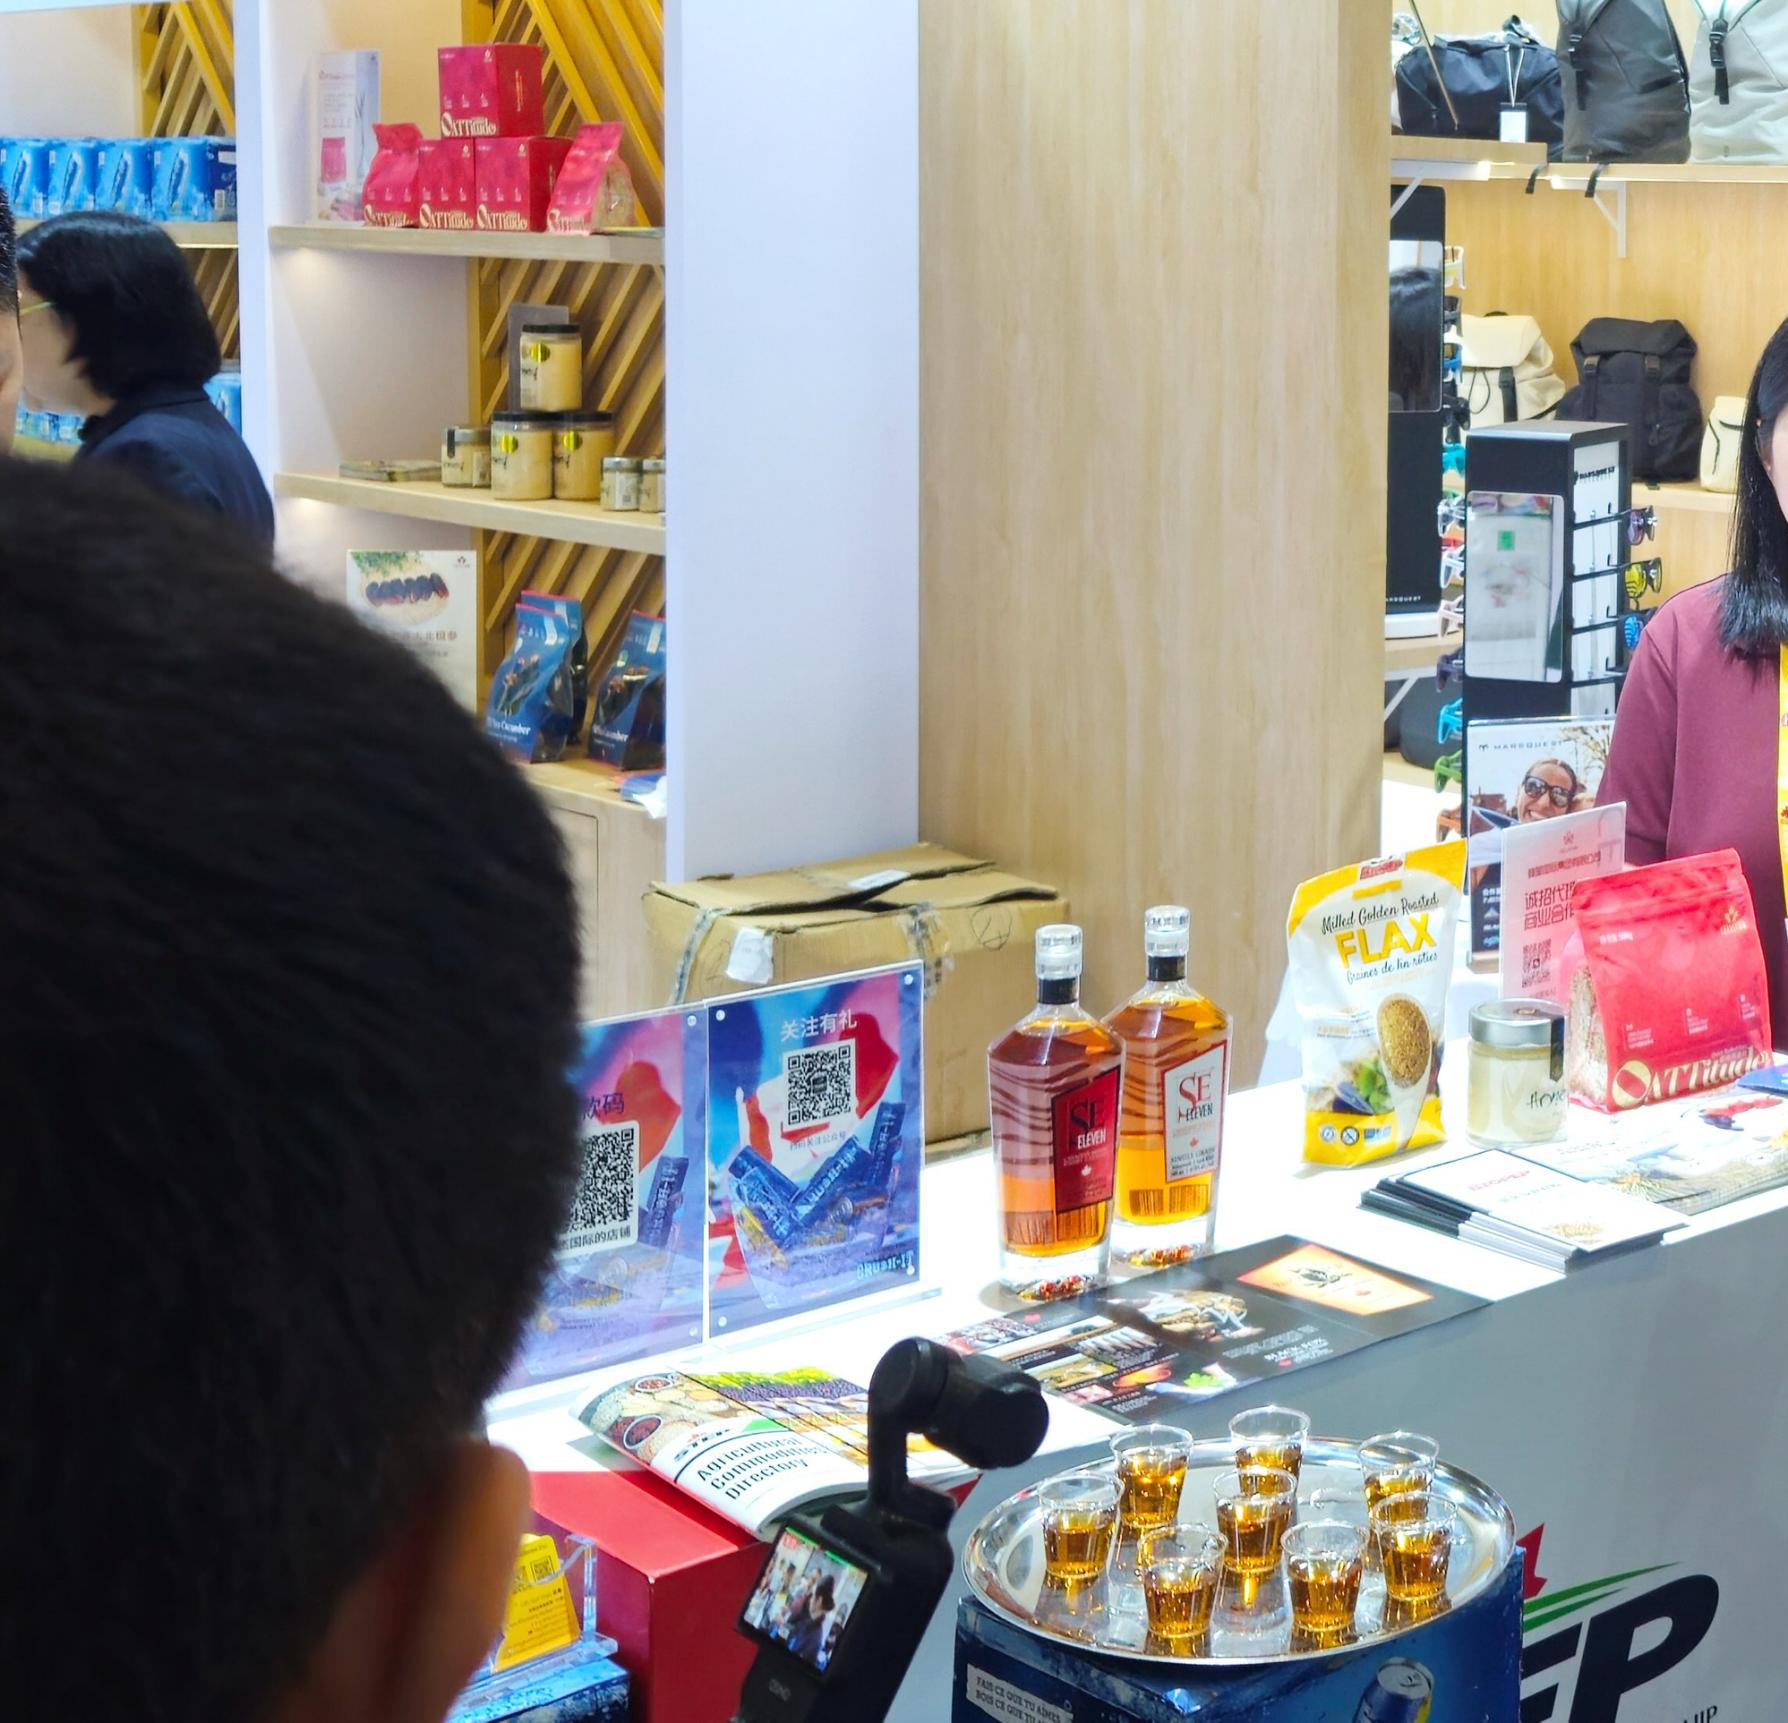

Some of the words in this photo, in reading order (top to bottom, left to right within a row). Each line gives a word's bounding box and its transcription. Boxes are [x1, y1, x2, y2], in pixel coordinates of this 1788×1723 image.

[1321, 911, 1356, 935] Milled
[1358, 906, 1399, 928] Golden
[1401, 891, 1440, 916] Roasted
[1334, 911, 1438, 968] FLAX
[1347, 966, 1379, 985] Graines
[1381, 960, 1395, 974] de
[1397, 957, 1411, 972] lin
[1412, 950, 1438, 967] rôties
[781, 1008, 857, 1042] 关注有礼
[1186, 1102, 1214, 1121] ELEVEN
[1077, 1128, 1107, 1150] ELEVEN
[697, 1437, 800, 1482] Agricultural
[711, 1446, 828, 1490] Commodities
[725, 1457, 809, 1500] Directory
[976, 1675, 993, 1694] FAIS
[994, 1683, 1006, 1699] CE
[1006, 1689, 1022, 1706] QUE
[1023, 1697, 1036, 1711] TU
[1036, 1702, 1061, 1723] AIMES
[976, 1690, 993, 1707] BOIS
[994, 1698, 1006, 1712] CE
[1006, 1703, 1023, 1720] QUE
[1024, 1711, 1037, 1723] TU
